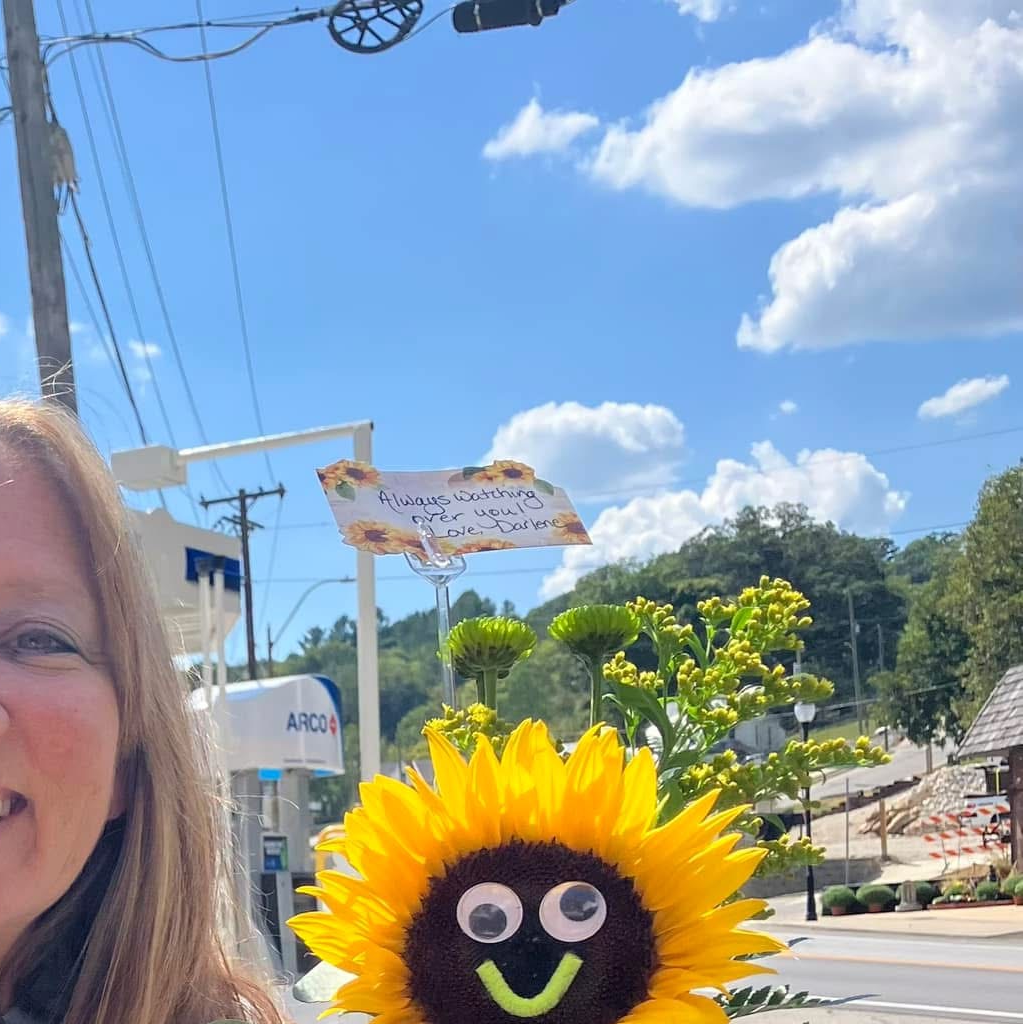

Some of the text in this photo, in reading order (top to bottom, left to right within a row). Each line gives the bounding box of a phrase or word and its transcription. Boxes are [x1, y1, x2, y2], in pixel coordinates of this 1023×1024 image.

[377, 488, 451, 515] Always
[411, 512, 464, 524] over
[495, 517, 567, 534] Darlene
[286, 711, 328, 734] ARCO
